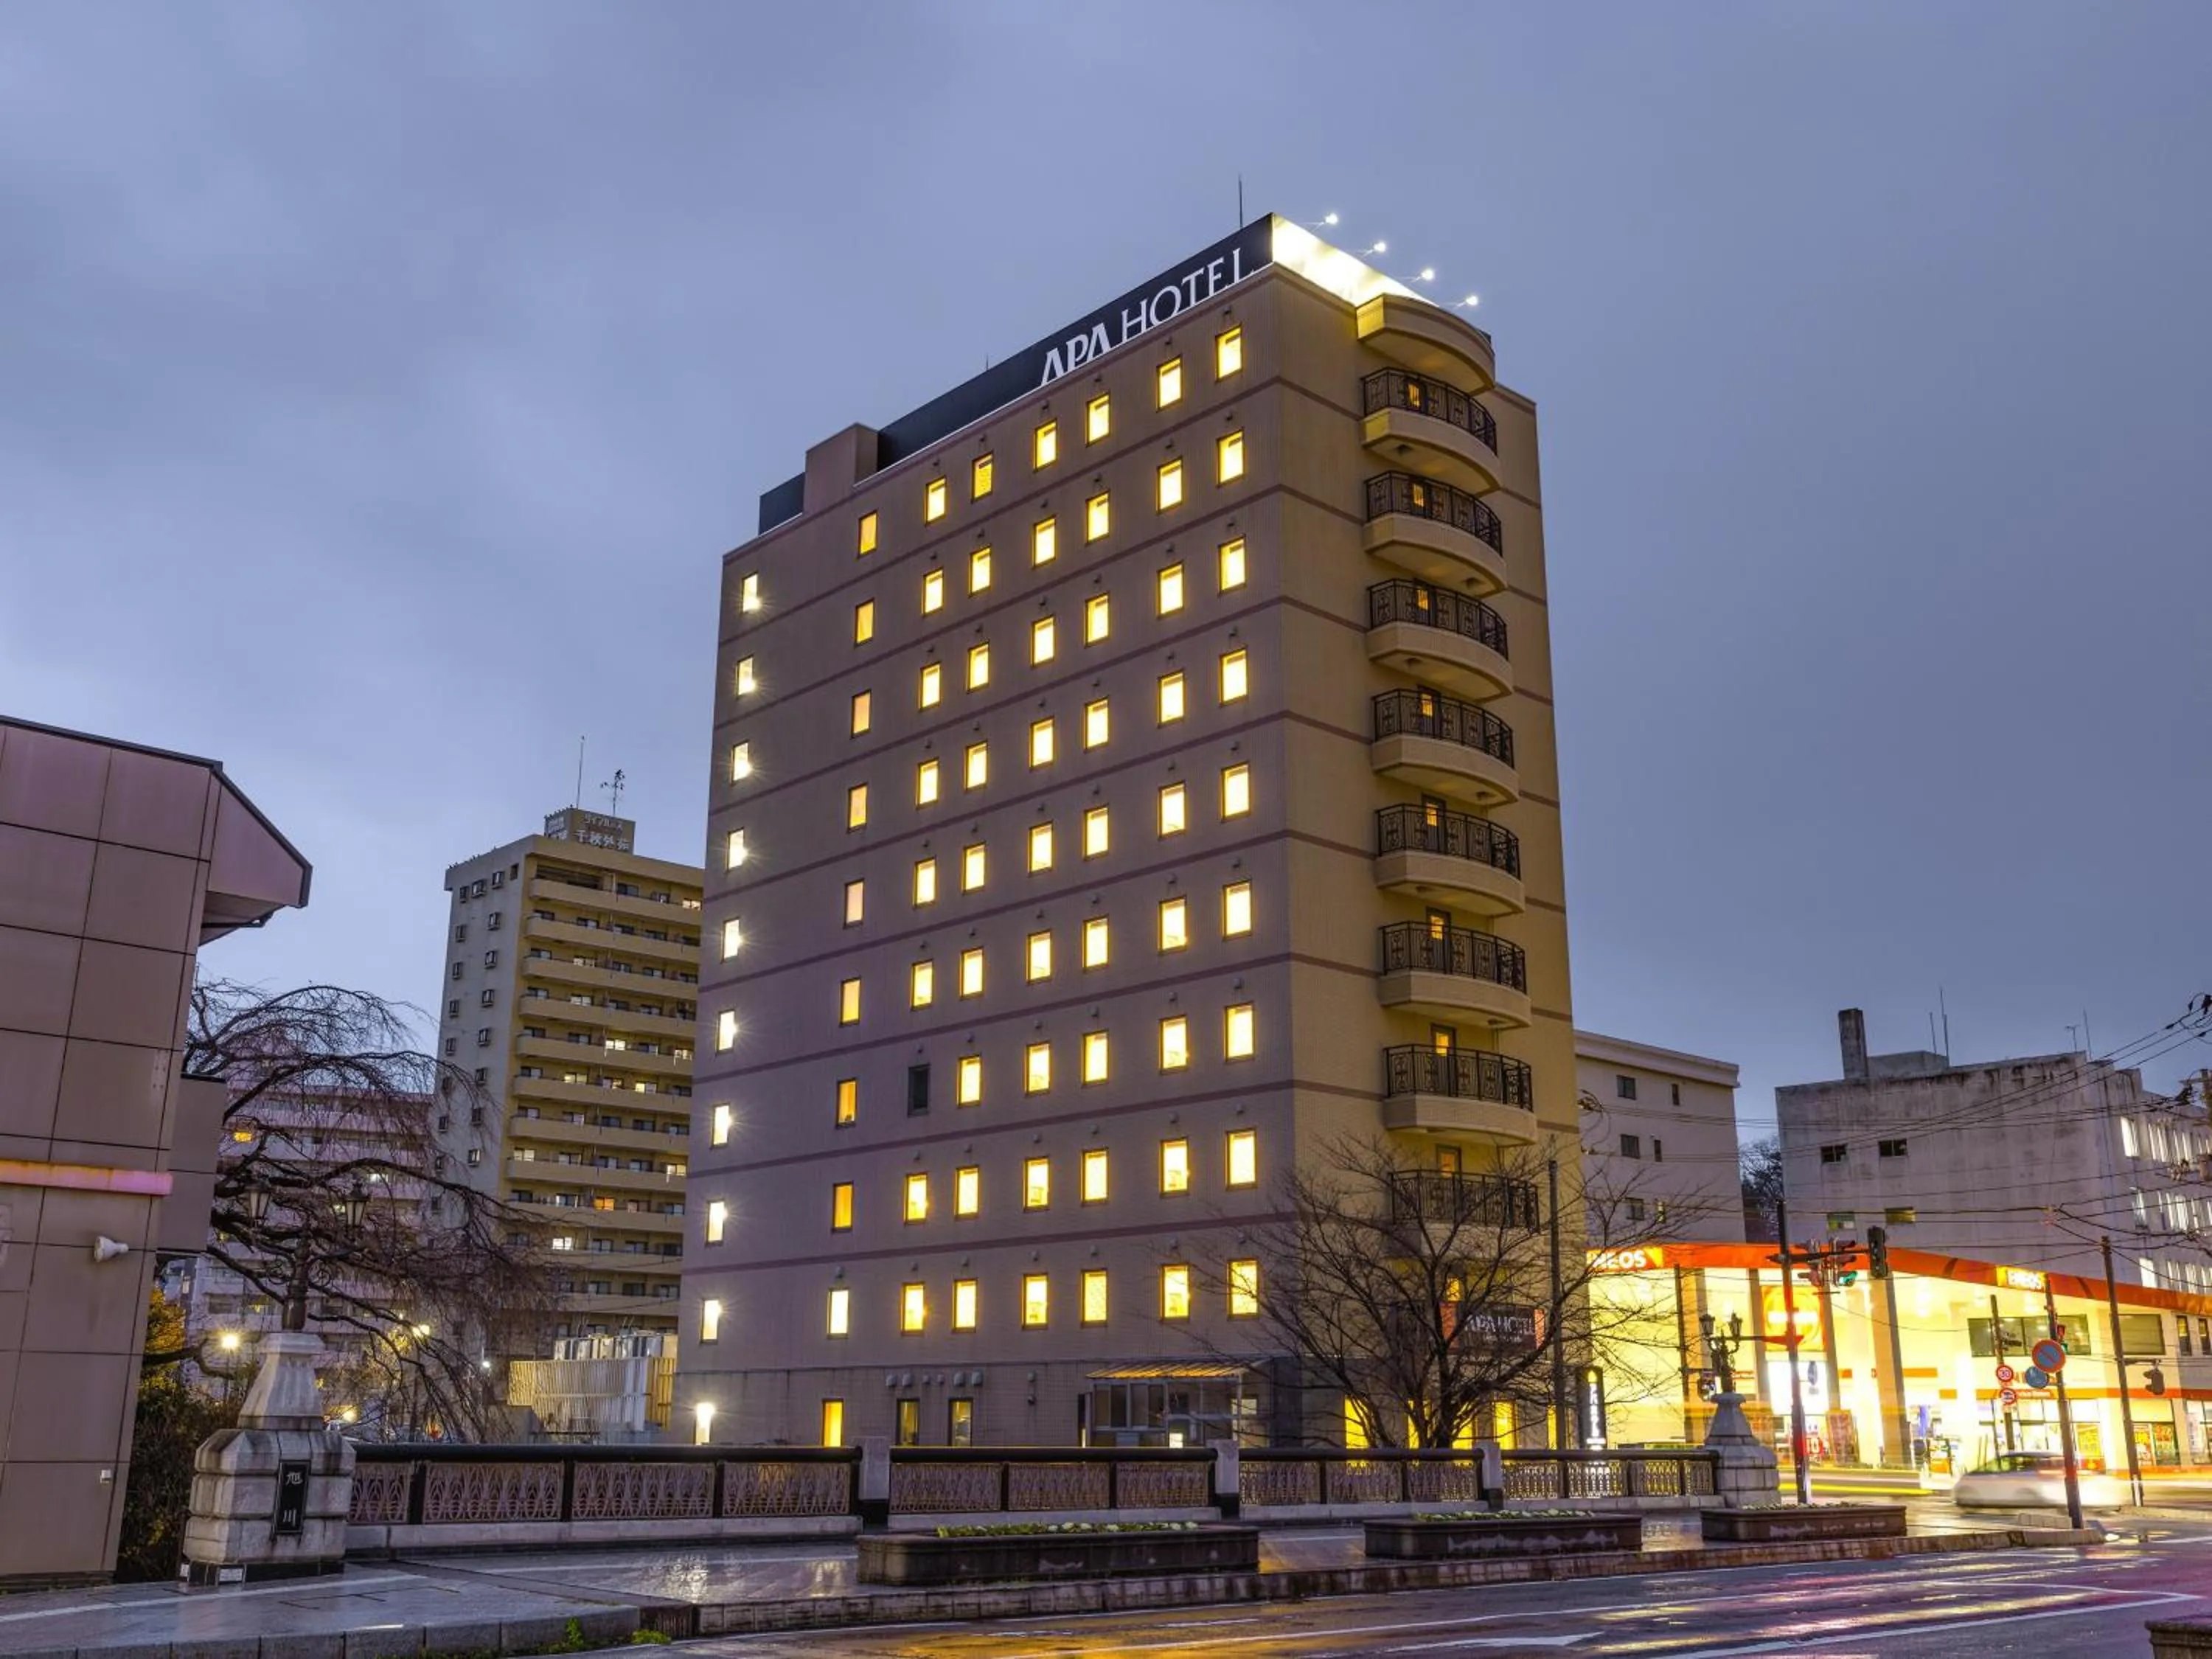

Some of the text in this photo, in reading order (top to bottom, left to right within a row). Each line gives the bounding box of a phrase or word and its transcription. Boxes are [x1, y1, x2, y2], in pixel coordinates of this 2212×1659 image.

[1040, 247, 1253, 386] APA HOTEL
[283, 1471, 303, 1528] 旭川
